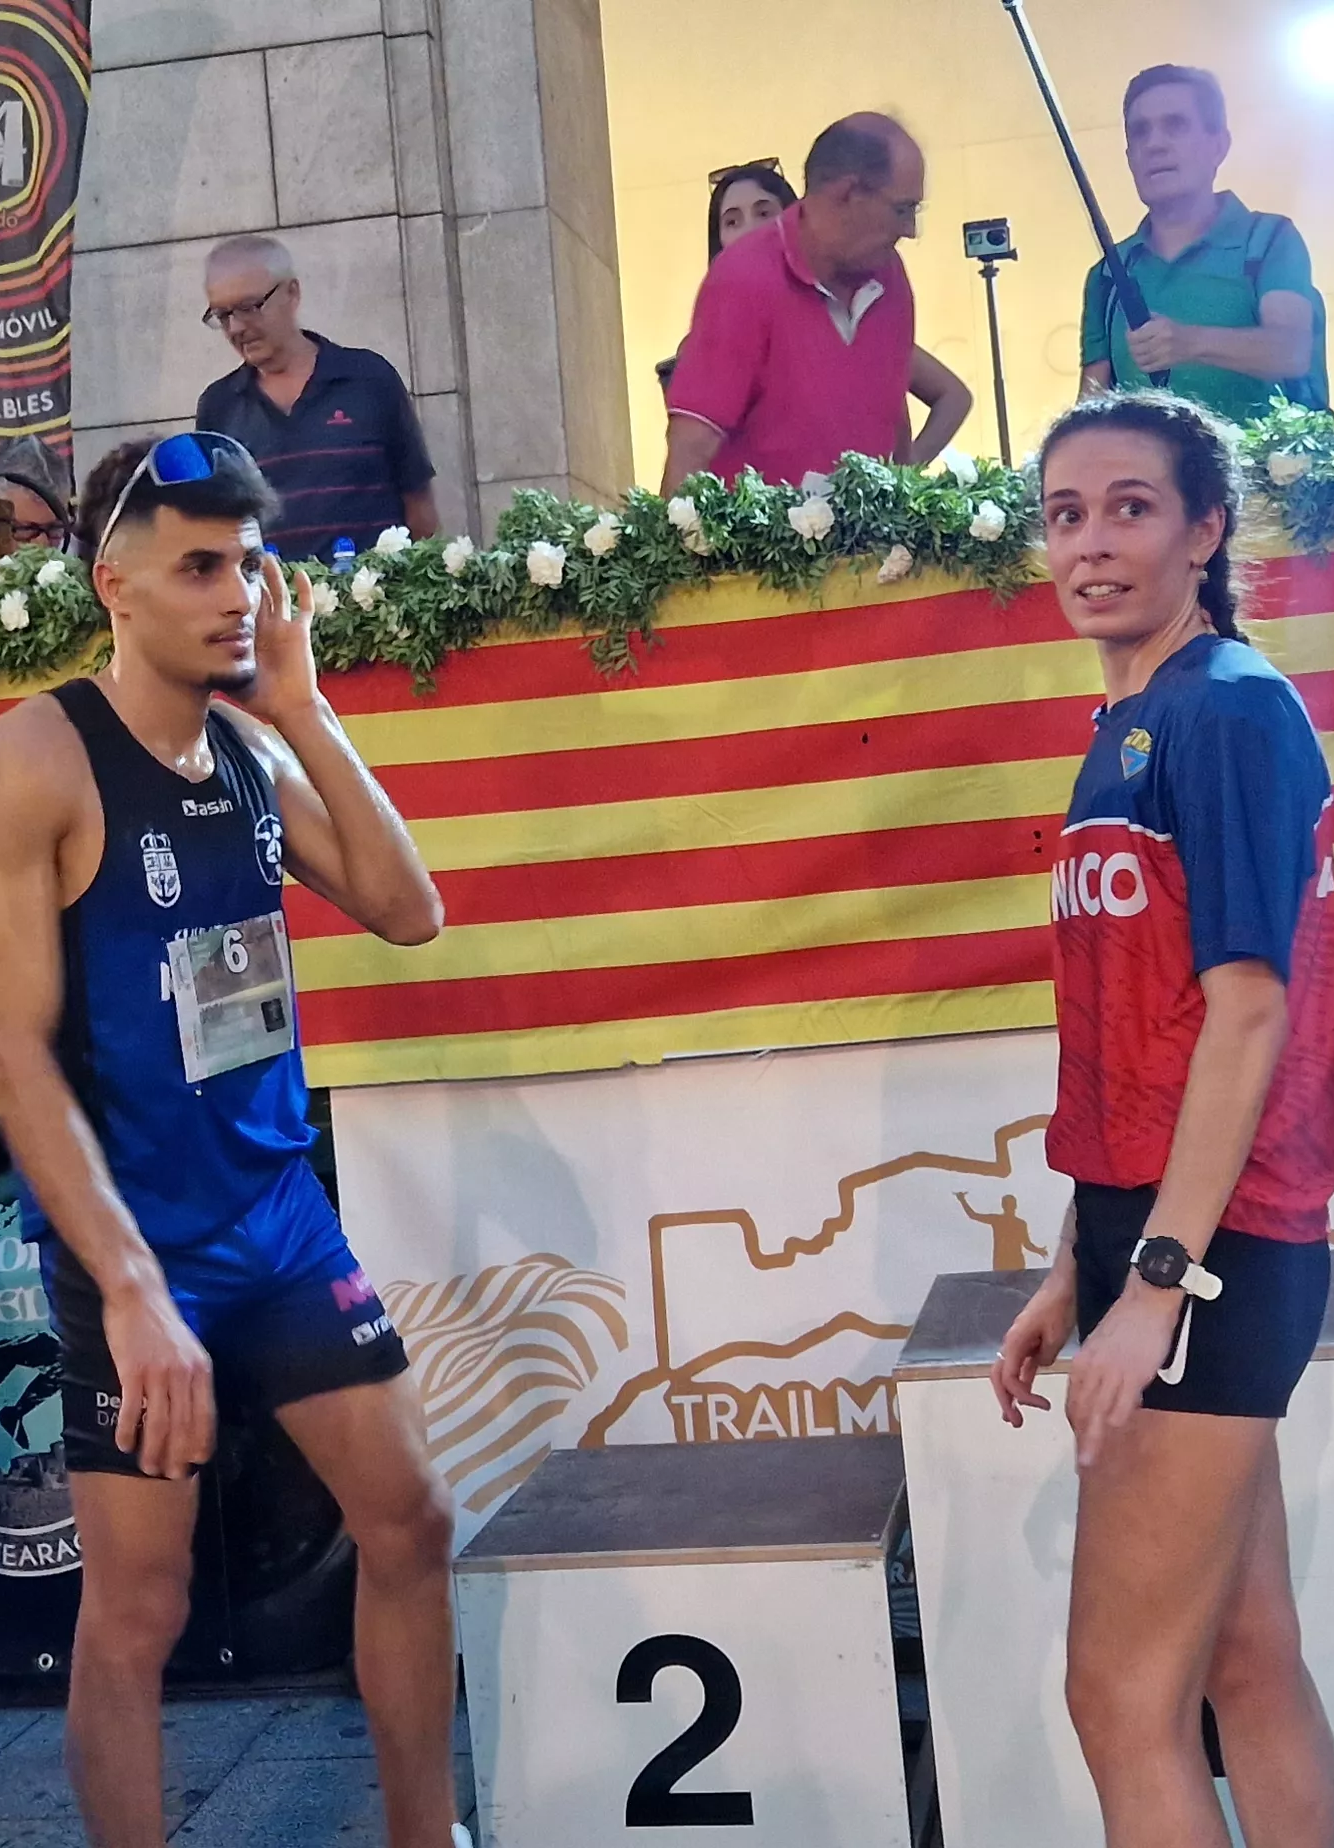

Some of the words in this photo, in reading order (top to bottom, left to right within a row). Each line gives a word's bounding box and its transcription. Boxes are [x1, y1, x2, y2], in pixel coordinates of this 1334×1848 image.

[222, 928, 249, 974] 6
[671, 1384, 901, 1442] TRAILM
[616, 1633, 755, 1827] 2
